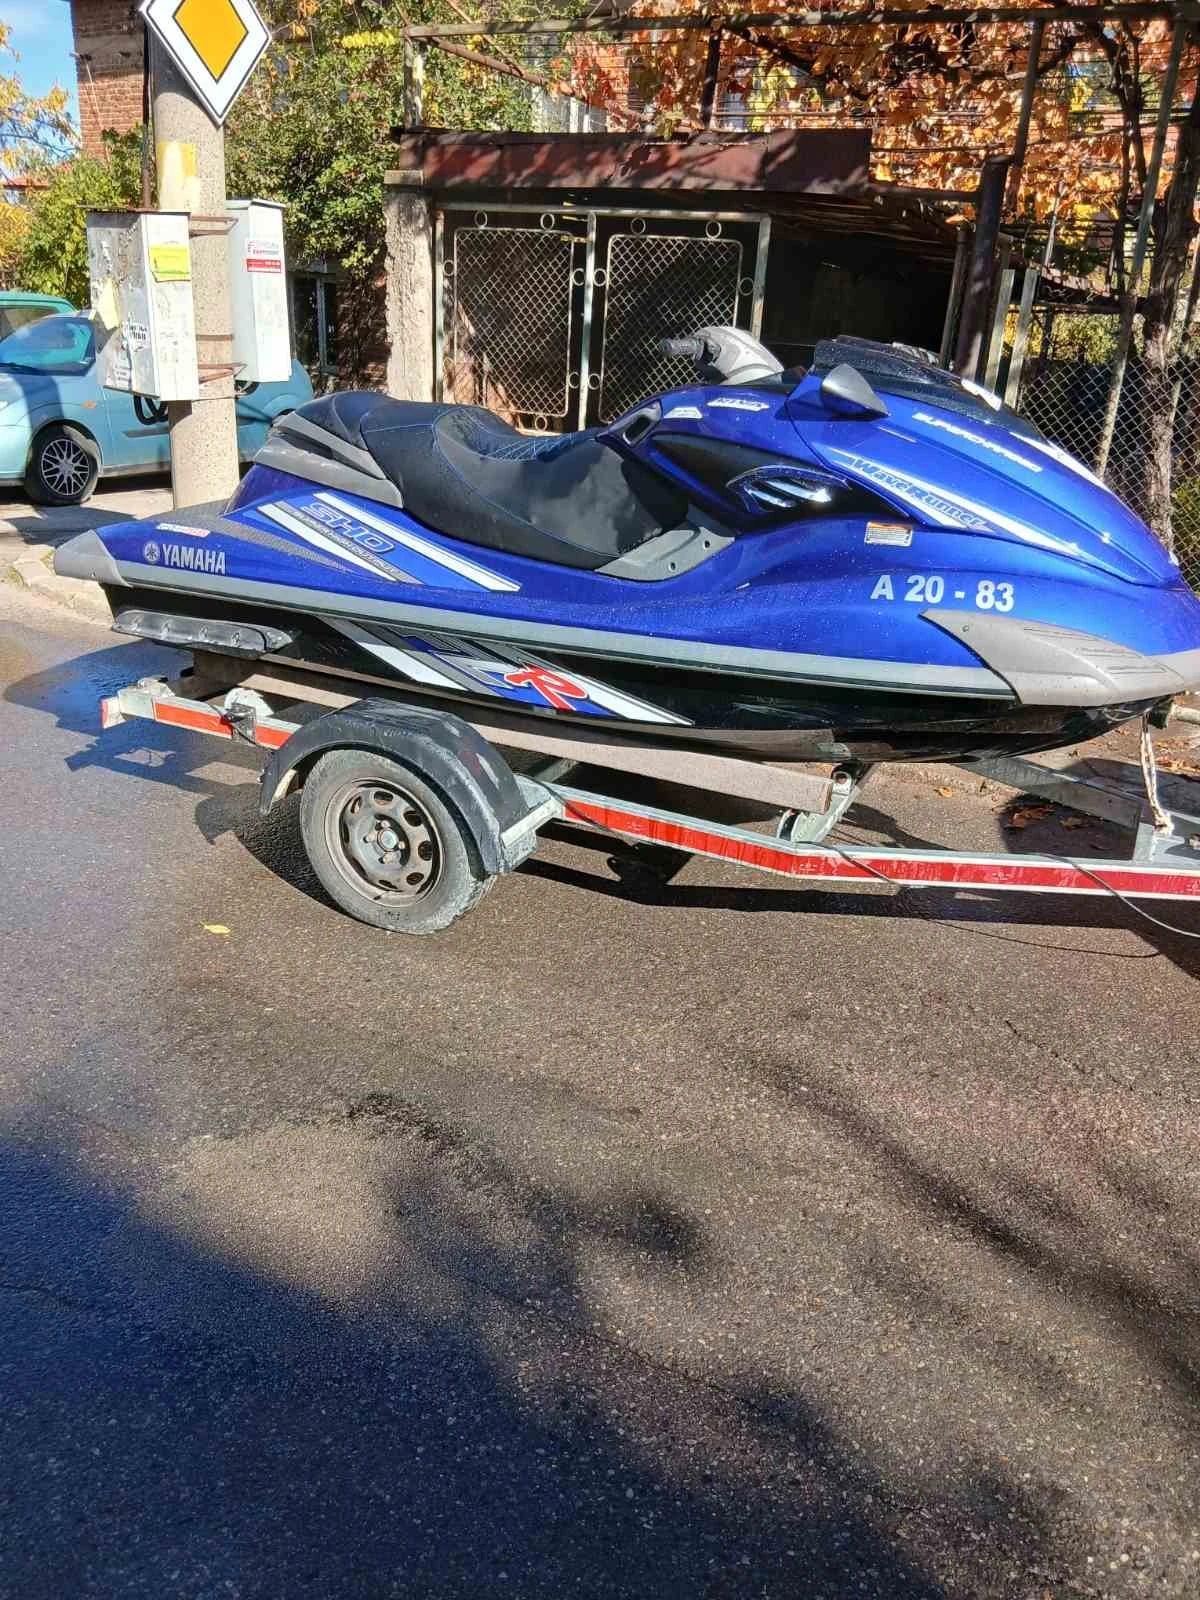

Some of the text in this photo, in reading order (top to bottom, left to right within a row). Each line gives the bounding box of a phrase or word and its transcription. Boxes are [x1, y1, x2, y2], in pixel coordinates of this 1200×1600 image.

[851, 456, 986, 526] WaveRunner
[301, 502, 395, 553] SHO
[162, 543, 226, 574] YAMAHA
[870, 574, 894, 600] A
[904, 574, 945, 604] 20
[975, 580, 1014, 612] 83
